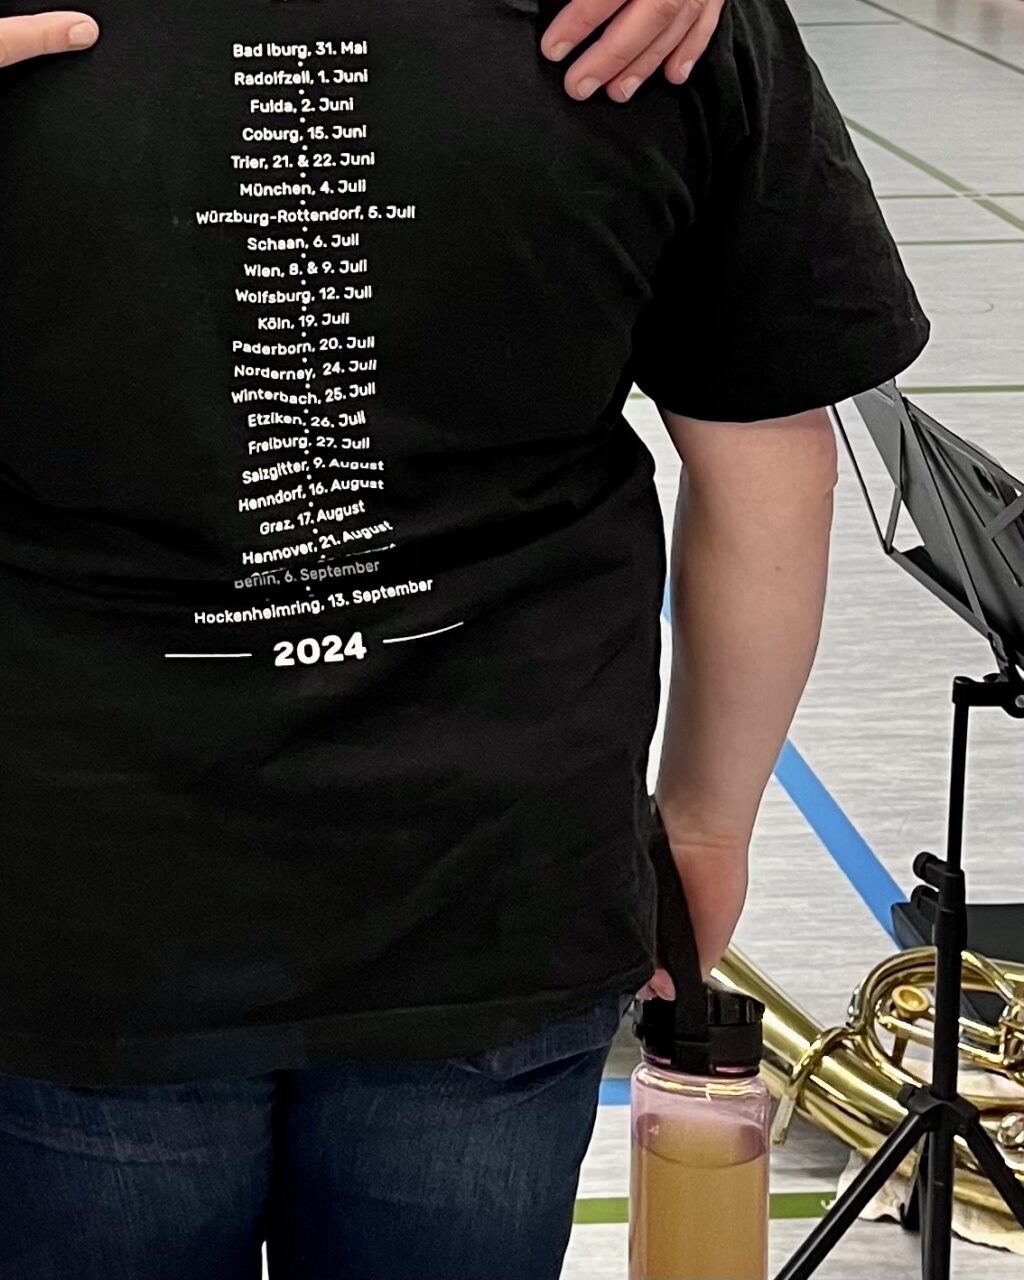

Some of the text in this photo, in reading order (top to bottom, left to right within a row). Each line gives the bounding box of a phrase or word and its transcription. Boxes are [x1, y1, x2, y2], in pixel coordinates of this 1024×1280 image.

[232, 40, 368, 60] Bad Iburg, 31. Mai
[234, 68, 369, 86] Radolfzell, 1. Juni
[250, 96, 354, 114] Fulda, 2. Juni
[241, 124, 367, 144] Coburg, 15. Juni
[230, 151, 376, 170] Trier, 21. & 22. Juni
[239, 178, 367, 198] München, 4. Juli
[385, 205, 416, 219] Juli
[247, 232, 360, 251] Schaan, 6. Juli
[243, 258, 368, 278] Wien, 8. & 9. Juli
[234, 284, 372, 305] Wolfsburg, 12. Juli
[257, 312, 350, 331] Köln, 19. Juli
[232, 335, 375, 356] Paderborn, 20. Juli
[234, 359, 378, 382] Norderney, 24. Juli
[230, 381, 376, 405] Winterbach, 25. Juli
[247, 409, 367, 429] Etziken, 26. Juli
[247, 435, 370, 455] Freiburg, 27. Juli
[241, 457, 385, 485] Salzgitter, 9. August
[238, 478, 385, 513] Henndorf, 16. August
[259, 499, 366, 536] Graz, 17. August
[242, 520, 394, 565] Hannover, 21. August
[285, 571, 297, 583] 6.
[300, 559, 380, 582] September
[194, 579, 434, 624] Hockenheimring, 13. September
[273, 631, 368, 667] 2024
